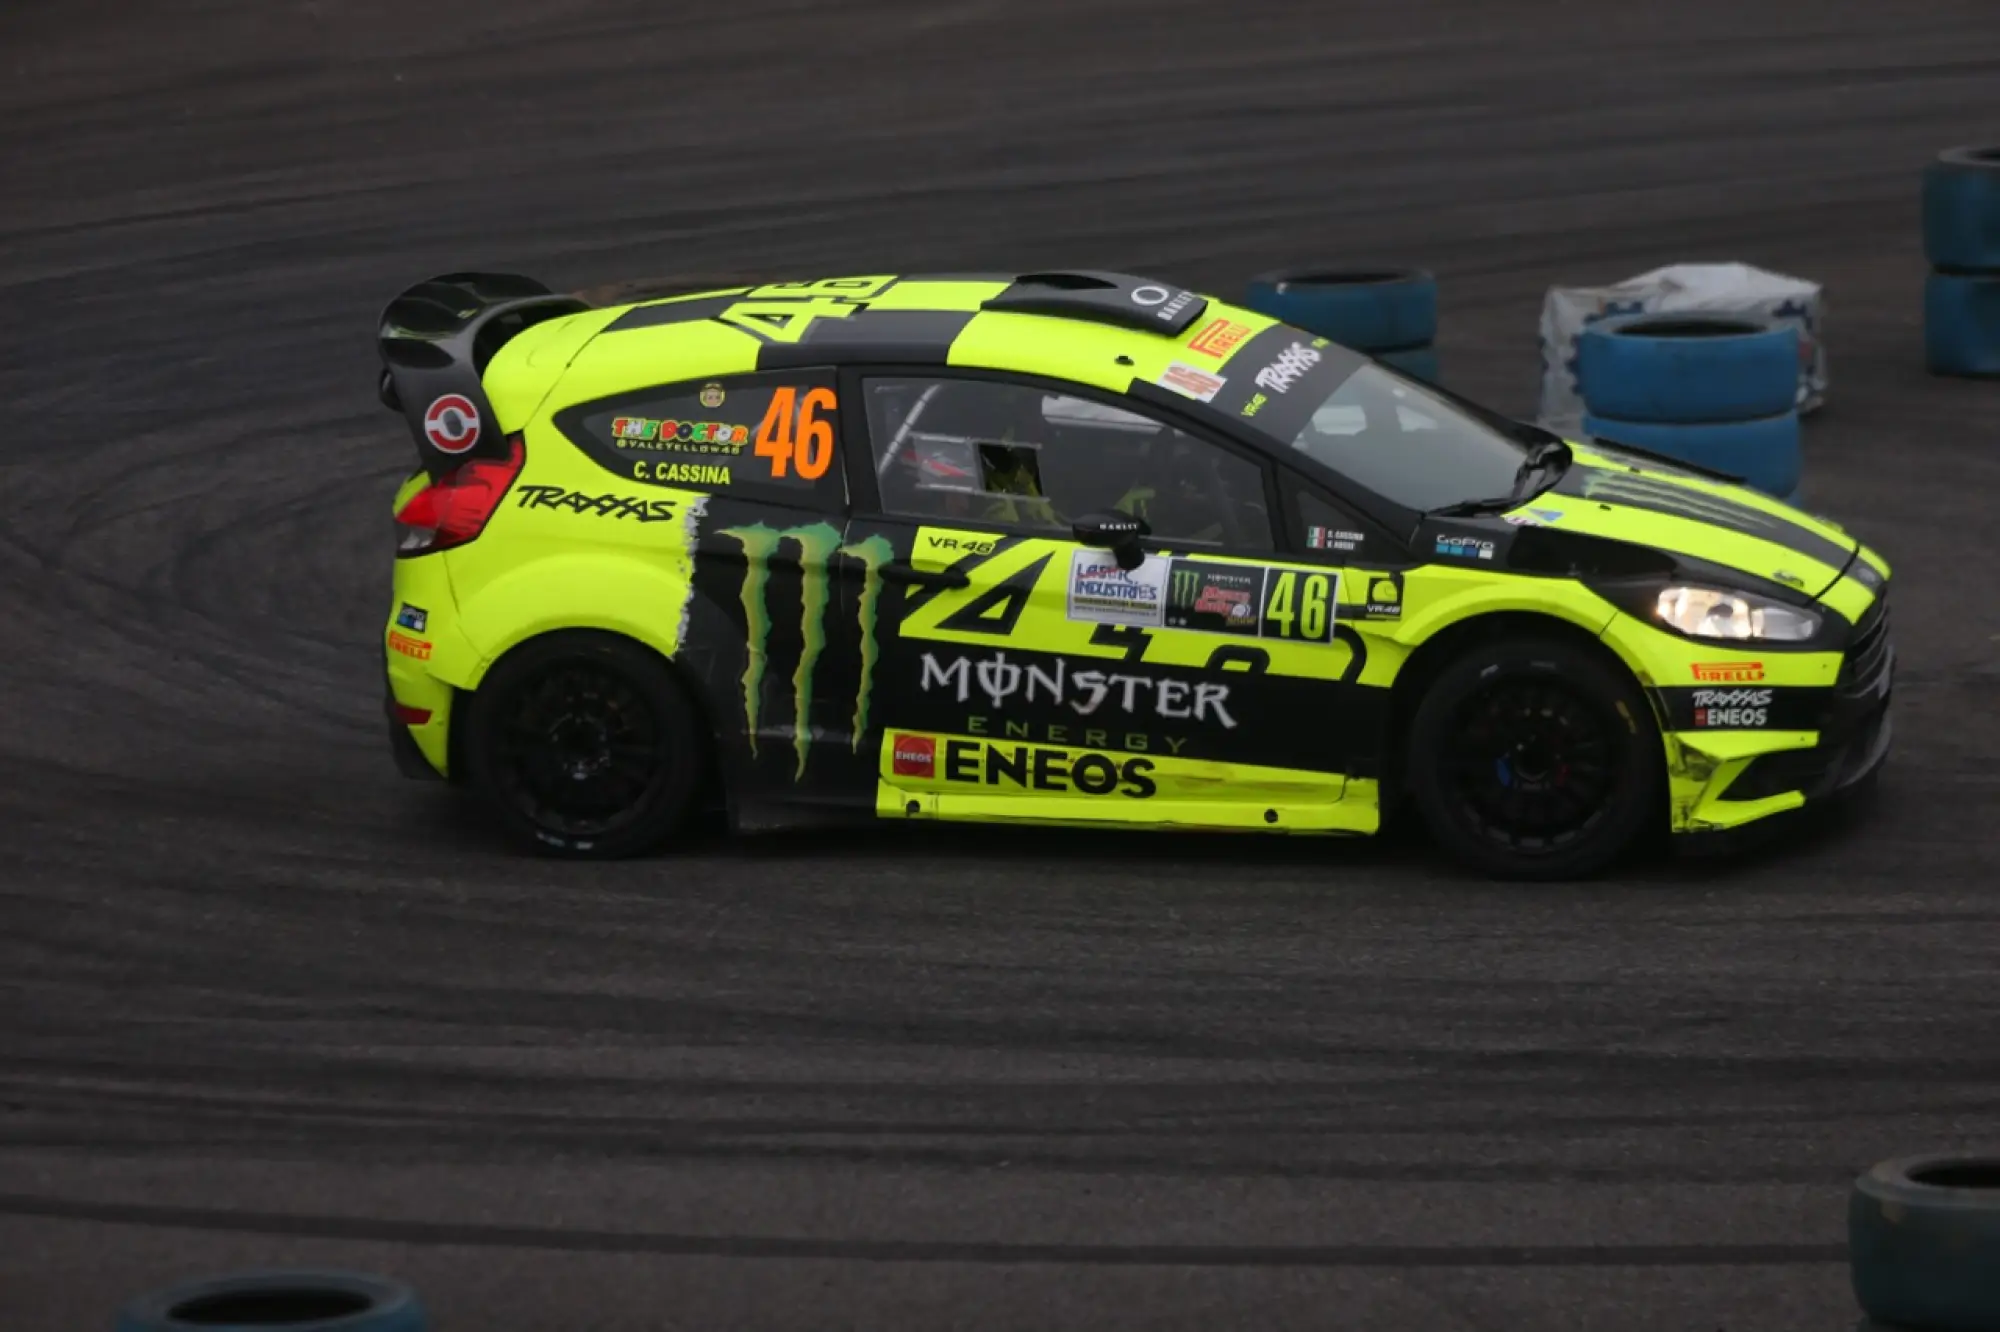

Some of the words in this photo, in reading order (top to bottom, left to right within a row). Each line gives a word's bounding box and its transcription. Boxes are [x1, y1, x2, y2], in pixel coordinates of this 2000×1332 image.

[1187, 317, 1252, 359] PIRELLI
[613, 418, 659, 440] THE
[660, 421, 748, 445] DOCTOR
[754, 386, 837, 481] 46
[634, 461, 649, 479] C.
[656, 463, 731, 485] CASSINA
[517, 485, 677, 522] TRAXXAS
[1436, 534, 1494, 549] GoPro
[1266, 571, 1328, 639] 46
[1691, 662, 1764, 681] PIRELLI
[921, 652, 1237, 728] MONSTER
[1692, 689, 1774, 707] TRAXXAS
[1707, 708, 1768, 726] ENEOS
[968, 716, 1187, 754] ENERGY
[895, 751, 932, 764] ENEOS
[946, 739, 1156, 799] ENEOS
